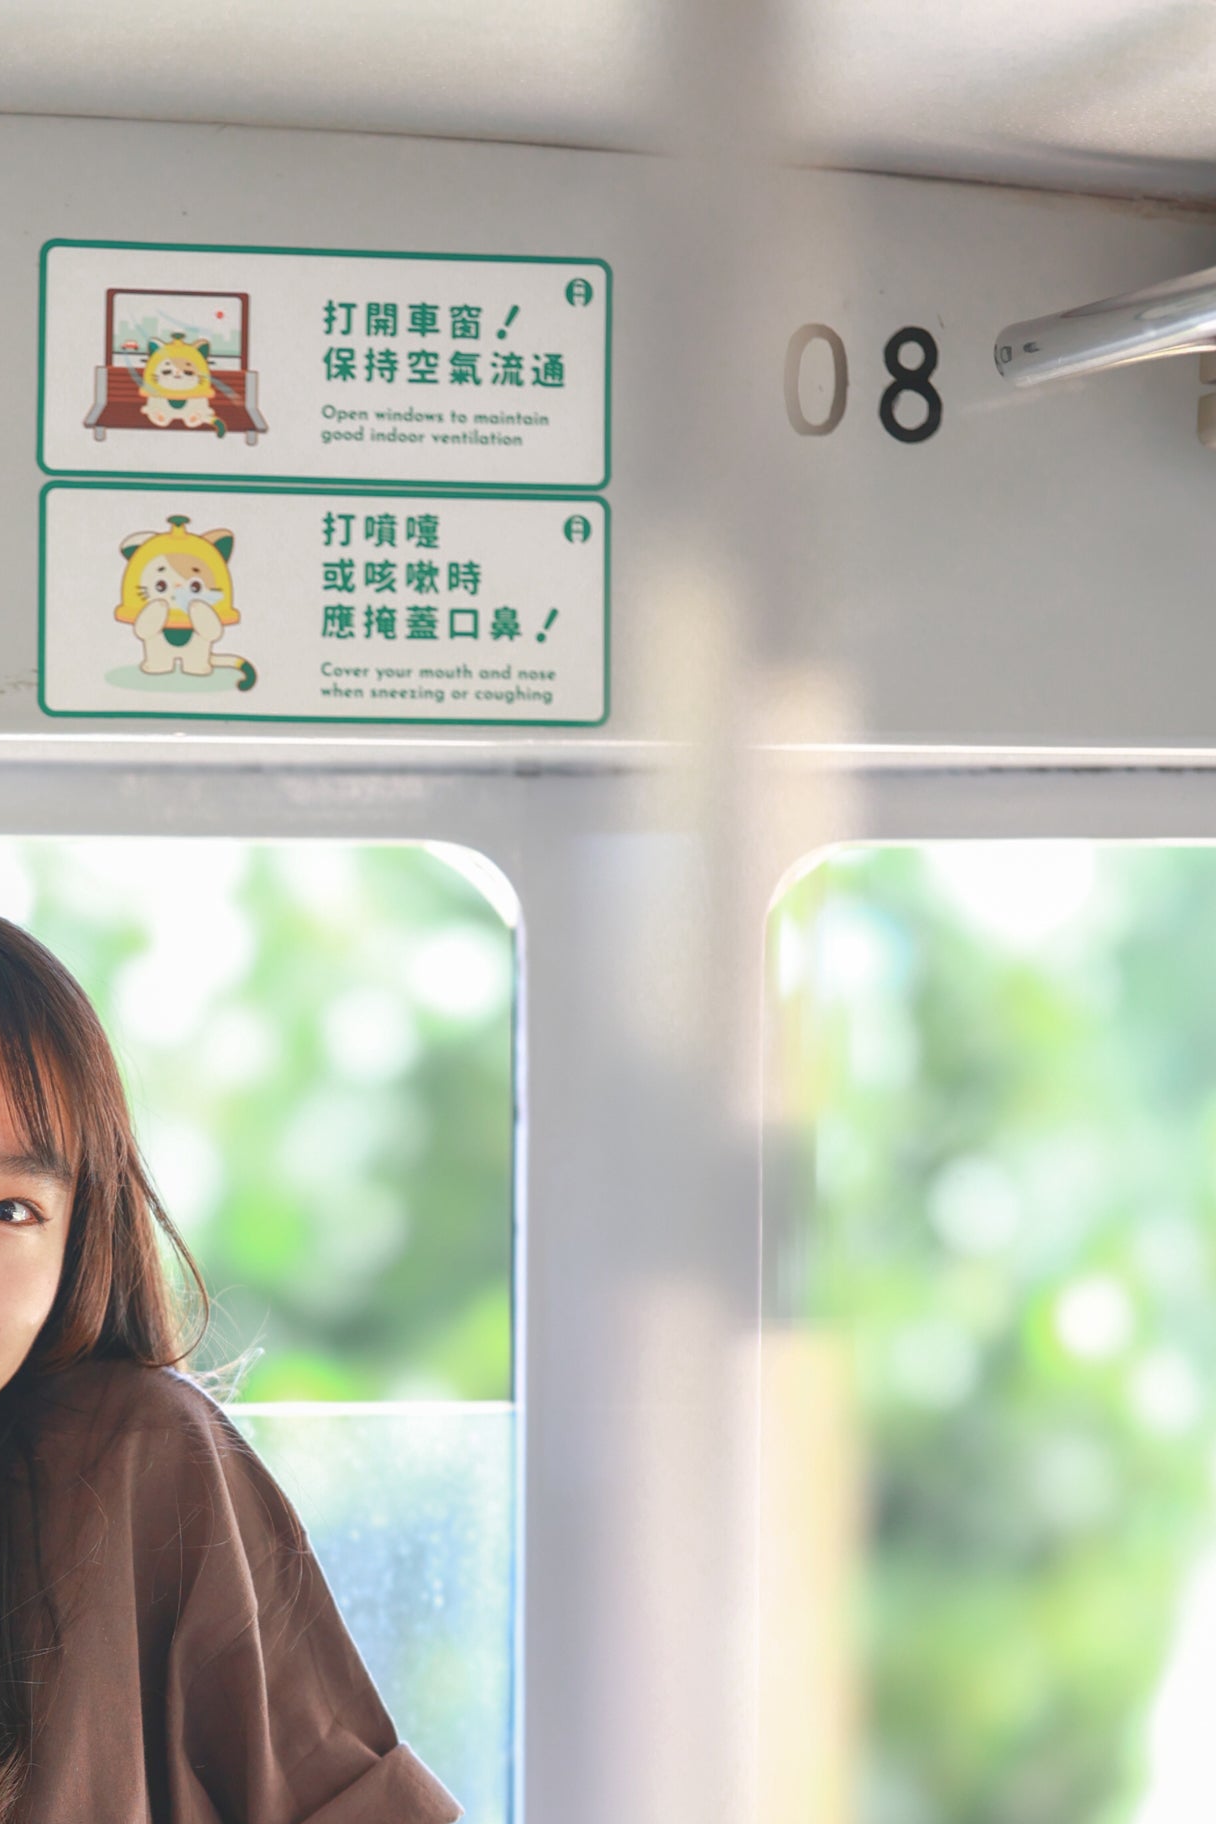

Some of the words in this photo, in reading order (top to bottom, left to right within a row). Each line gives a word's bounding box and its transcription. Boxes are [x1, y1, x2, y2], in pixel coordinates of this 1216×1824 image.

[322, 347, 566, 389] 保持空氣流通
[785, 323, 942, 444] 08
[321, 404, 369, 423] Open
[374, 406, 445, 424] windows
[450, 410, 468, 425] to
[473, 411, 550, 427] maintain
[321, 427, 365, 446] good
[370, 427, 426, 445] indoor
[431, 430, 523, 447] ventilation
[322, 512, 440, 549] 打噴嚏
[322, 558, 482, 596] 或咳嗽時
[320, 662, 370, 679] Cover
[375, 667, 414, 684] your
[419, 664, 474, 681] mouth
[479, 665, 513, 682] and
[517, 669, 557, 683] nose
[320, 683, 365, 700] when
[370, 686, 446, 705] sneezing
[451, 689, 470, 702] or
[474, 686, 555, 707] coughing
